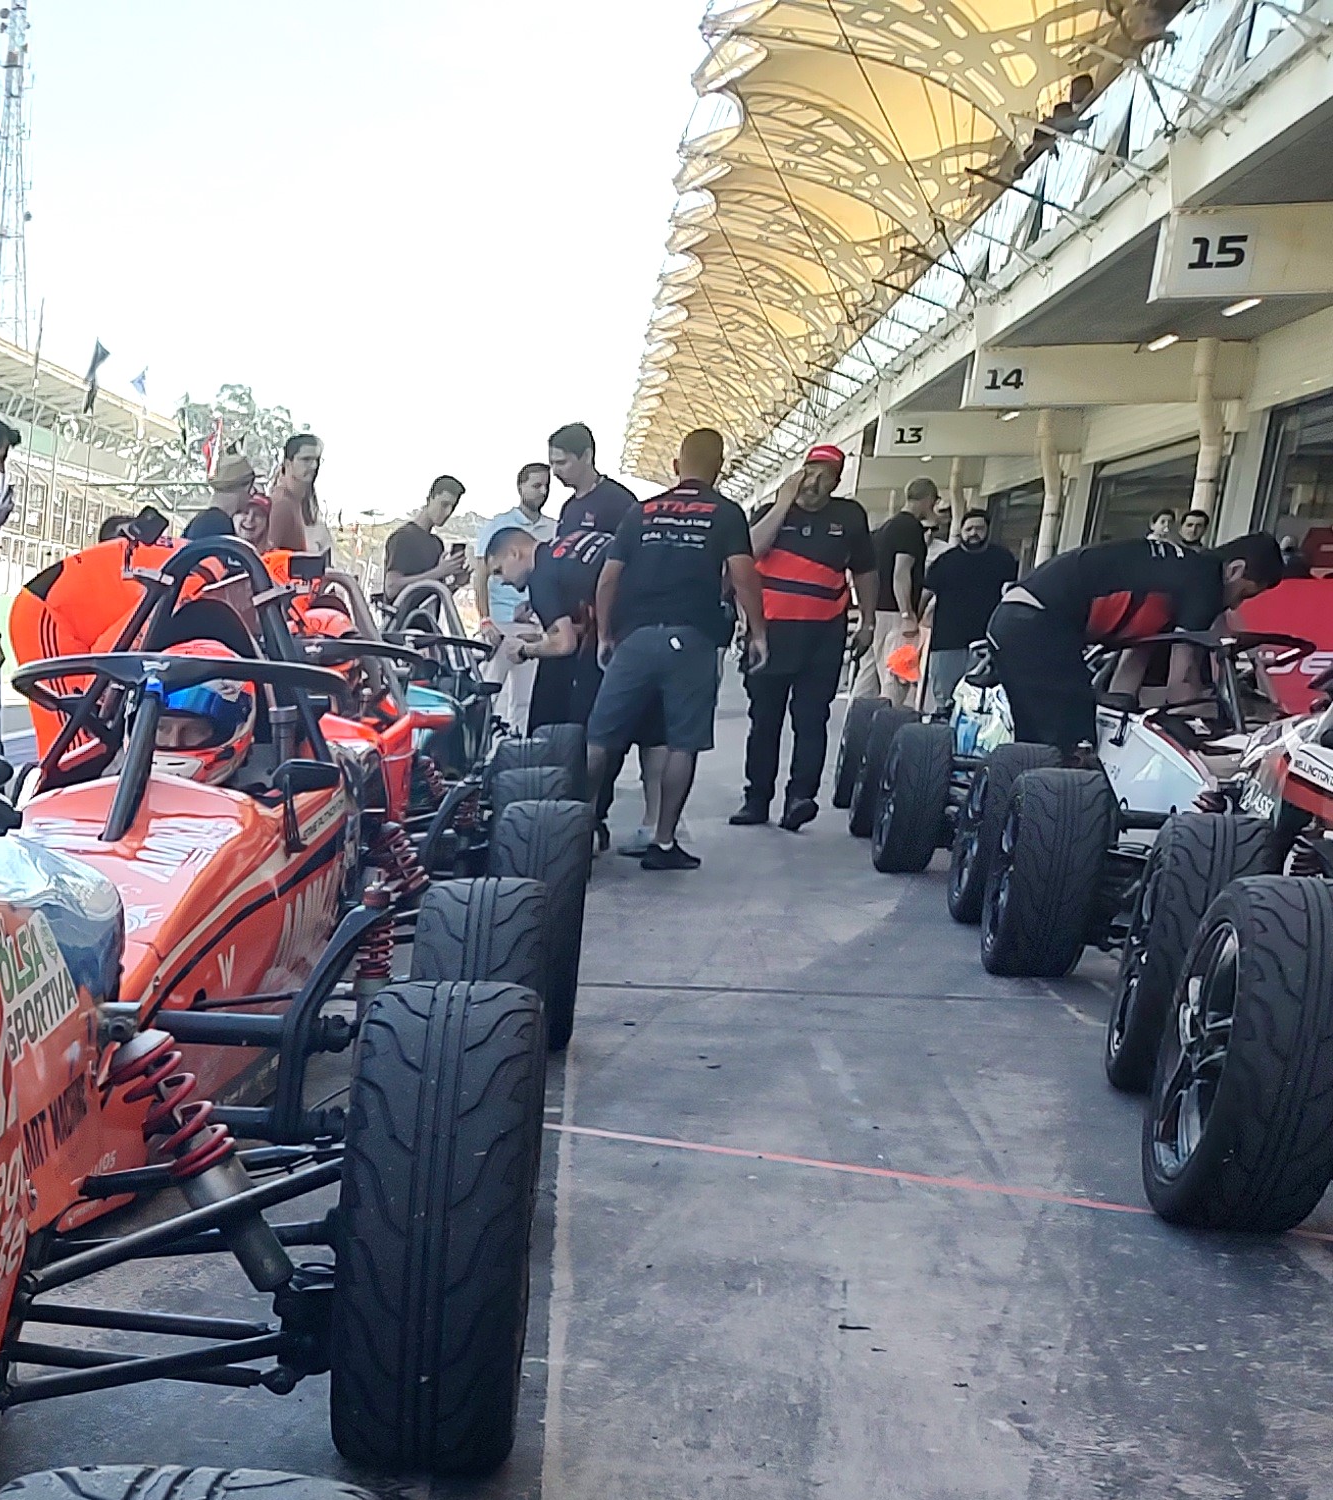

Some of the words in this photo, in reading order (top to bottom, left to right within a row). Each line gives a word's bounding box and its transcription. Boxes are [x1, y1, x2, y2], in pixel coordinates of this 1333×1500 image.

[1187, 234, 1248, 270] 15
[984, 368, 1024, 391] 14
[894, 426, 924, 444] 13
[4, 967, 79, 1063] SPORTIVA
